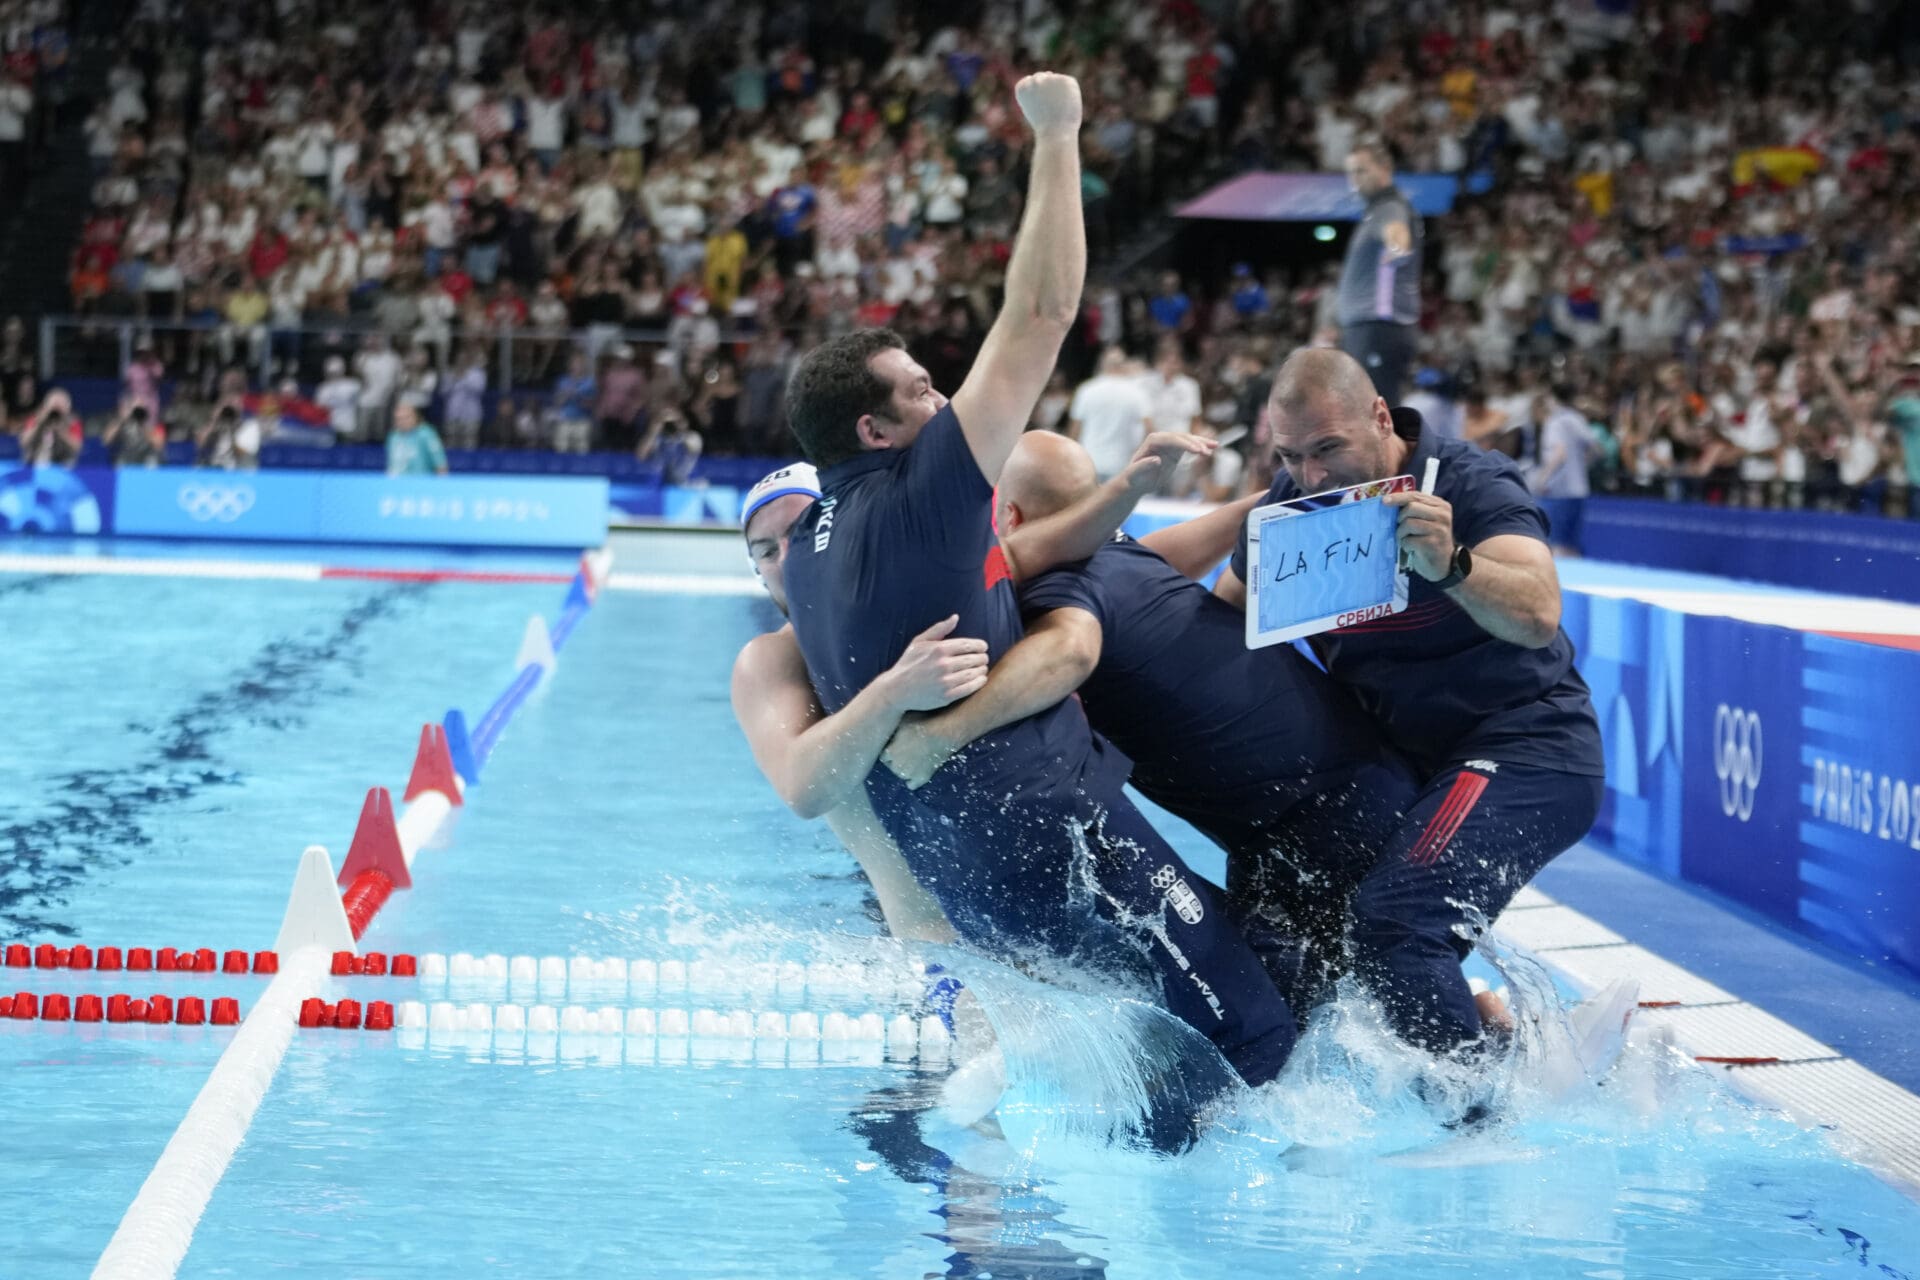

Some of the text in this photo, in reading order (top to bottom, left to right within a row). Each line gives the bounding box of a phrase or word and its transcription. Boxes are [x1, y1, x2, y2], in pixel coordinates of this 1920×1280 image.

[1275, 551, 1307, 582] LA
[1336, 603, 1393, 627] СРБИЈА
[1189, 972, 1225, 1021] TEAM
